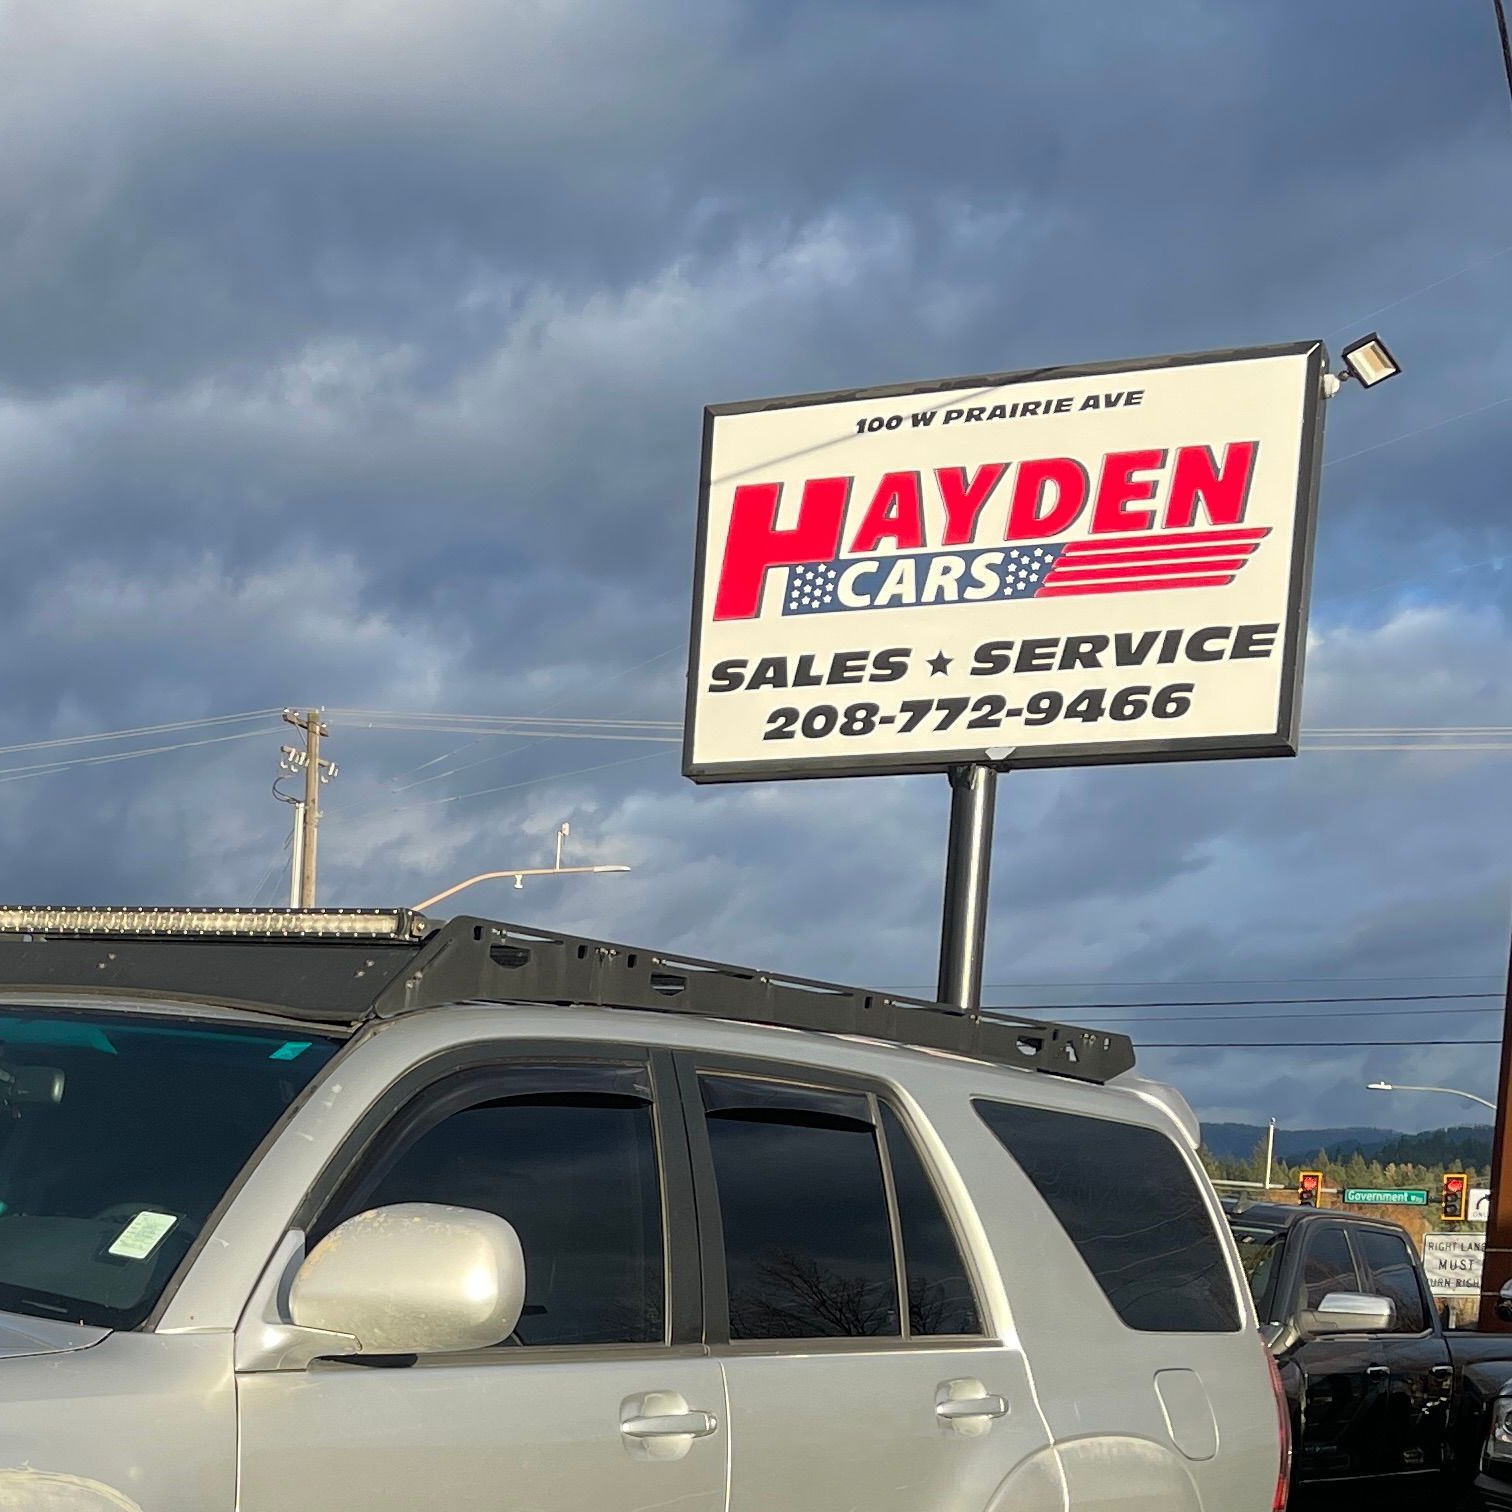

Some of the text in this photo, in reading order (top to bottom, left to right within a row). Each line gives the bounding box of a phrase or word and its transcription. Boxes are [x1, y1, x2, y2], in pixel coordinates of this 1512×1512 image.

[855, 389, 1146, 434] 100 W PRAIRIE AVE
[713, 440, 1261, 622] HAYDEN
[836, 548, 1011, 609] CARS
[708, 622, 1281, 693] SALES SERVICE
[762, 682, 1196, 742] 208-772-9466
[1348, 1189, 1409, 1202] Government
[1428, 1241, 1458, 1252] RIGHT
[1438, 1258, 1475, 1271] MUST
[1429, 1278, 1480, 1288] URN RIGH
